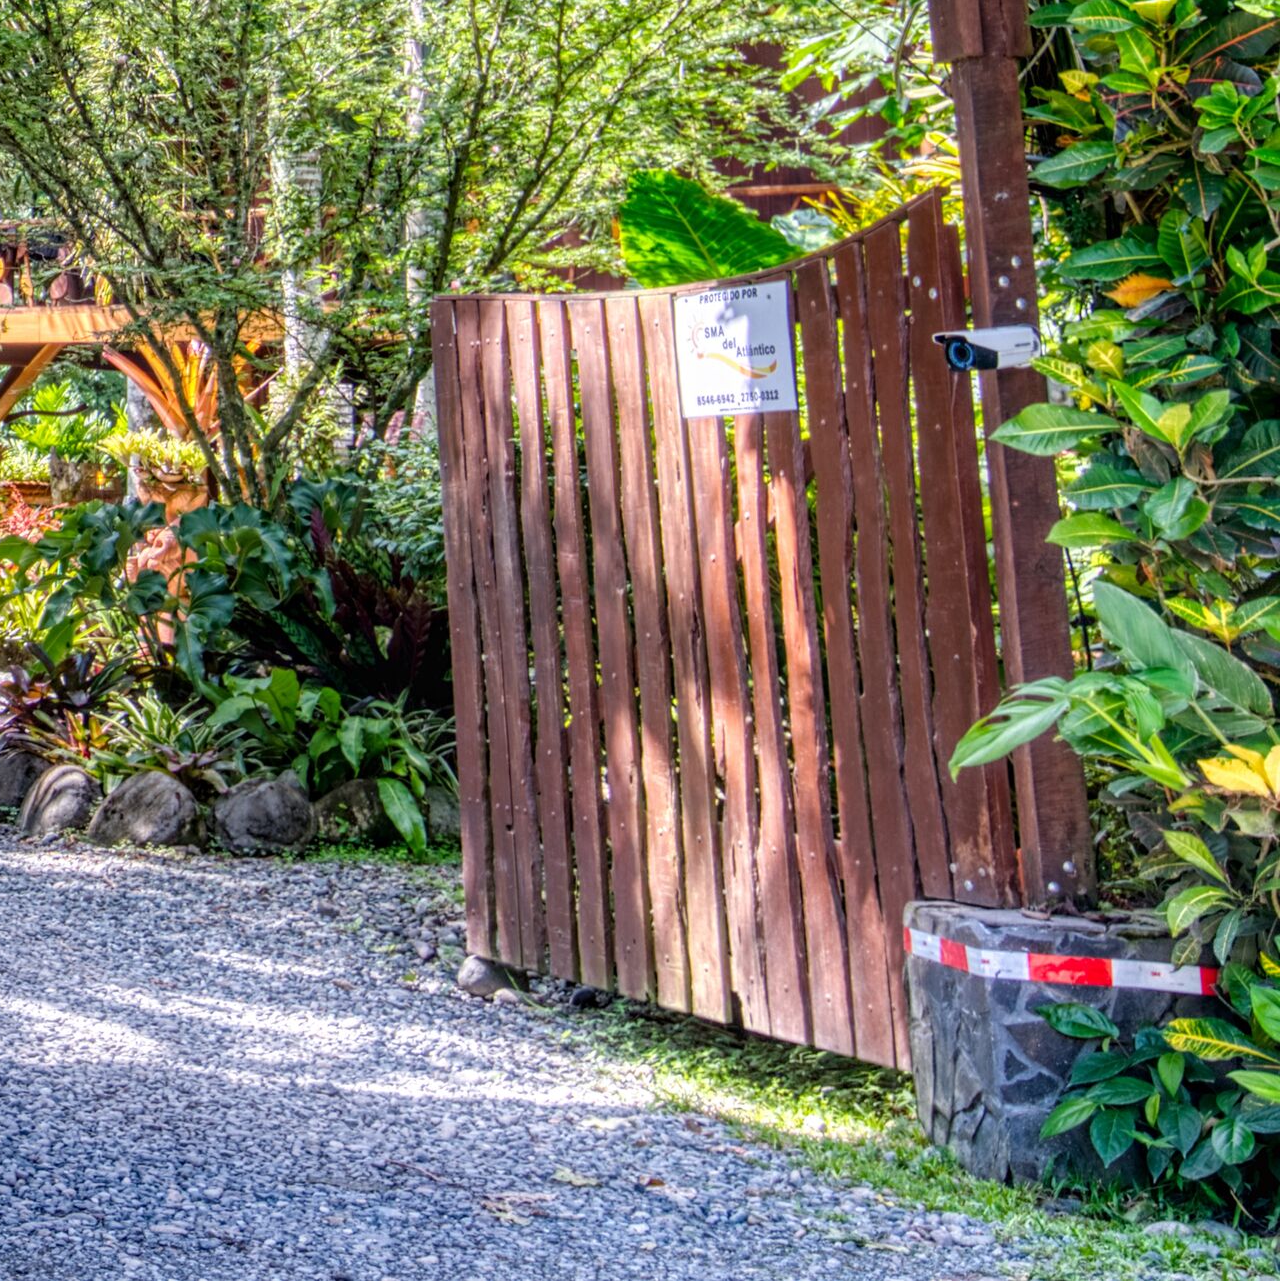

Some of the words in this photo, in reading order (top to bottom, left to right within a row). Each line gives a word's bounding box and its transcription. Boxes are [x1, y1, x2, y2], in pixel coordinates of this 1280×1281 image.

[699, 290, 740, 304] PROTEGIDO
[741, 287, 758, 299] POR
[704, 325, 725, 339] SMA
[722, 337, 737, 350] del
[736, 343, 776, 358] Atlántico
